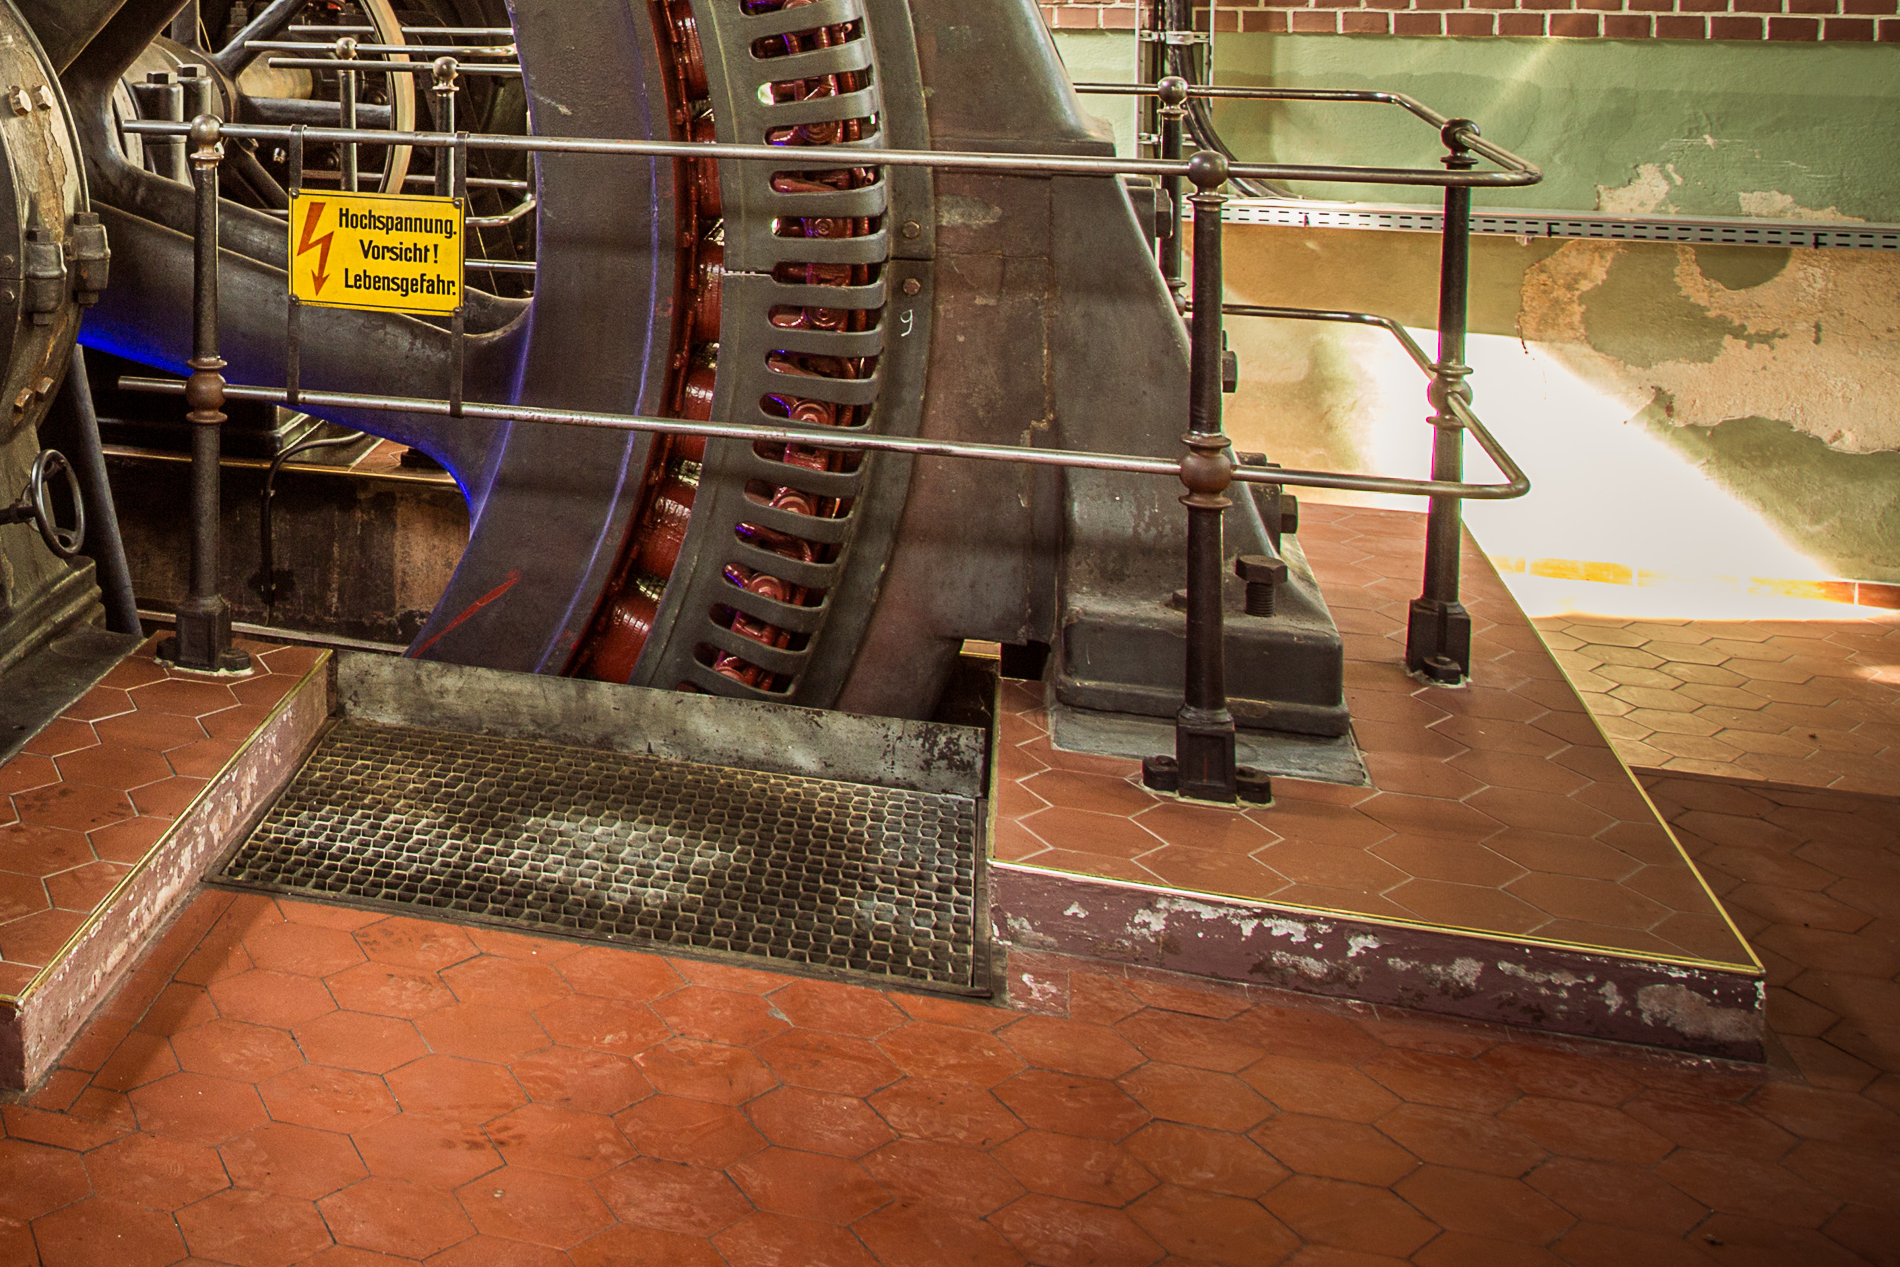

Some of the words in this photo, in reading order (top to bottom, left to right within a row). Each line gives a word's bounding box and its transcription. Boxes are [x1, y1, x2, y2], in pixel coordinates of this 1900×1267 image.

[338, 207, 458, 239] Hochspannung.
[344, 268, 457, 297] Lebensgefahr.
[900, 308, 913, 337] 9
